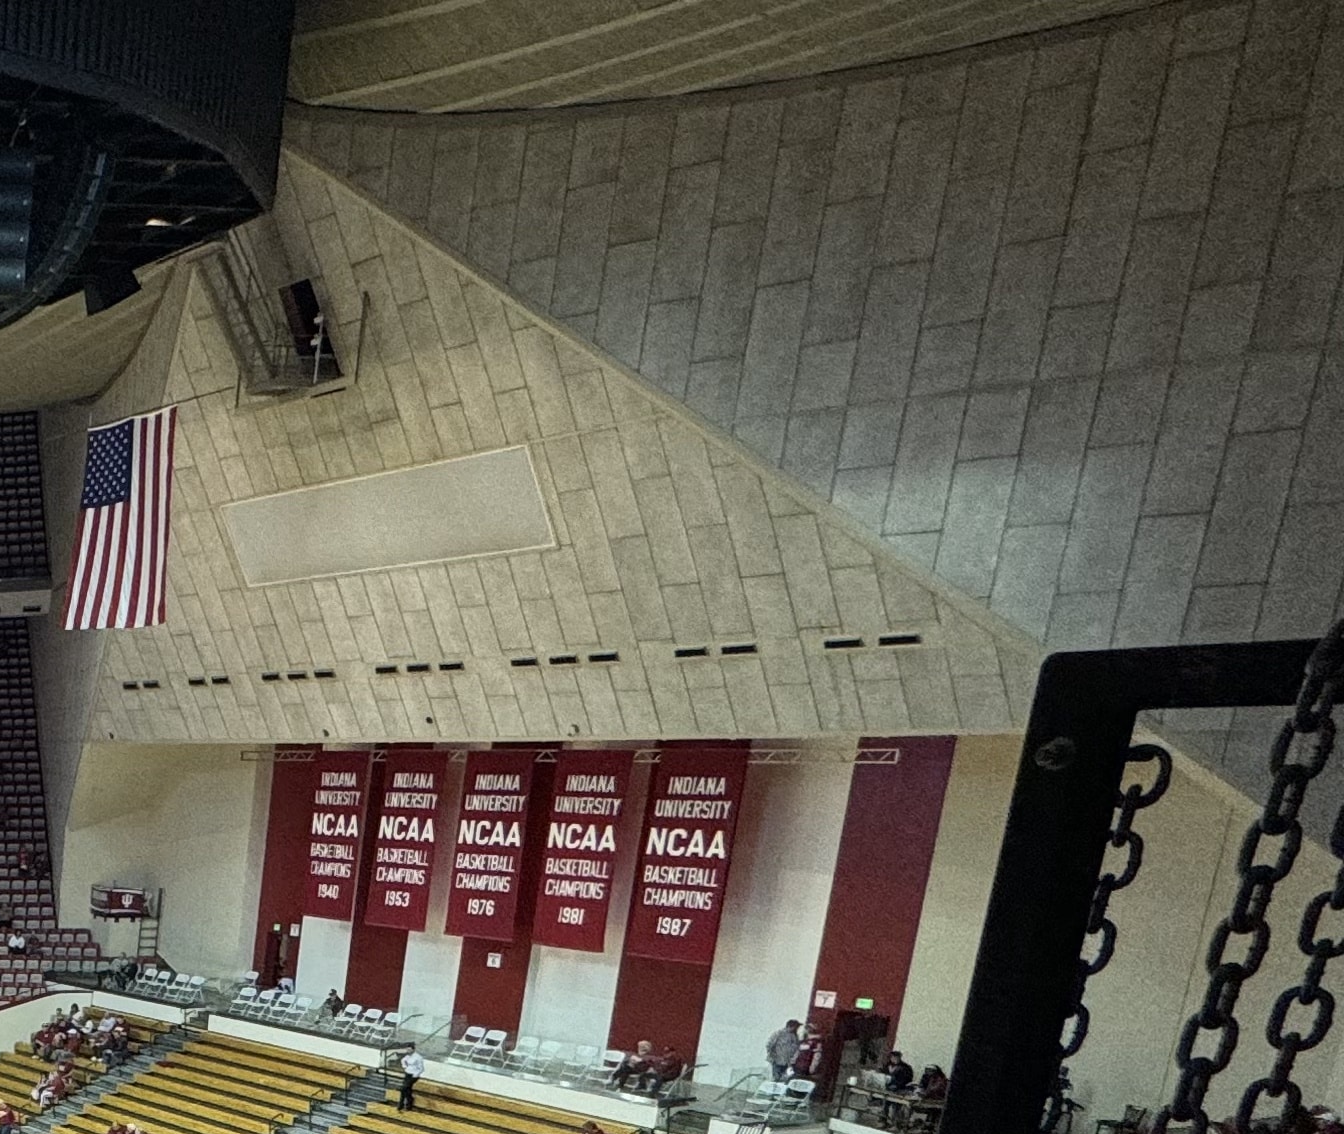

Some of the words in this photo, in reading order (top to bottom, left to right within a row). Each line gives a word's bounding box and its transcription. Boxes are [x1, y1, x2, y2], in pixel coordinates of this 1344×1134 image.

[321, 772, 357, 788] INDIANA
[393, 772, 434, 789] INDIANA
[475, 774, 520, 791] INDIANA
[566, 774, 616, 793] INDIANA
[668, 776, 726, 795] INDIANA
[315, 790, 361, 806] UNIVERSITY
[385, 792, 438, 810] UNIVERSITY
[464, 794, 526, 812] UNIVERSITY
[554, 796, 622, 816] UNIVERSITY
[654, 799, 732, 820] UNIVERSITY
[311, 812, 359, 838] NCAA
[378, 815, 435, 842] NCAA
[457, 820, 521, 847] NCAA
[547, 822, 616, 852] NCAA
[646, 826, 726, 860] NCAA
[310, 842, 355, 861] BASKETBALL
[377, 847, 429, 867] BASKETBALL
[310, 861, 352, 879] CHAMPIONS
[455, 852, 515, 873] BASKETBALL
[545, 858, 609, 879] BASKETBALL
[376, 866, 426, 885] CHAMPIONS
[455, 872, 511, 893] CHAMPIONS
[643, 865, 718, 888] BASKETBALL
[318, 884, 339, 900] 1940
[385, 890, 410, 908] 1953
[545, 879, 605, 900] CHAMPIONS
[643, 887, 714, 911] CHAMPIONS
[467, 897, 495, 917] 1976
[557, 906, 585, 925] 1981
[656, 916, 692, 936] 1987
